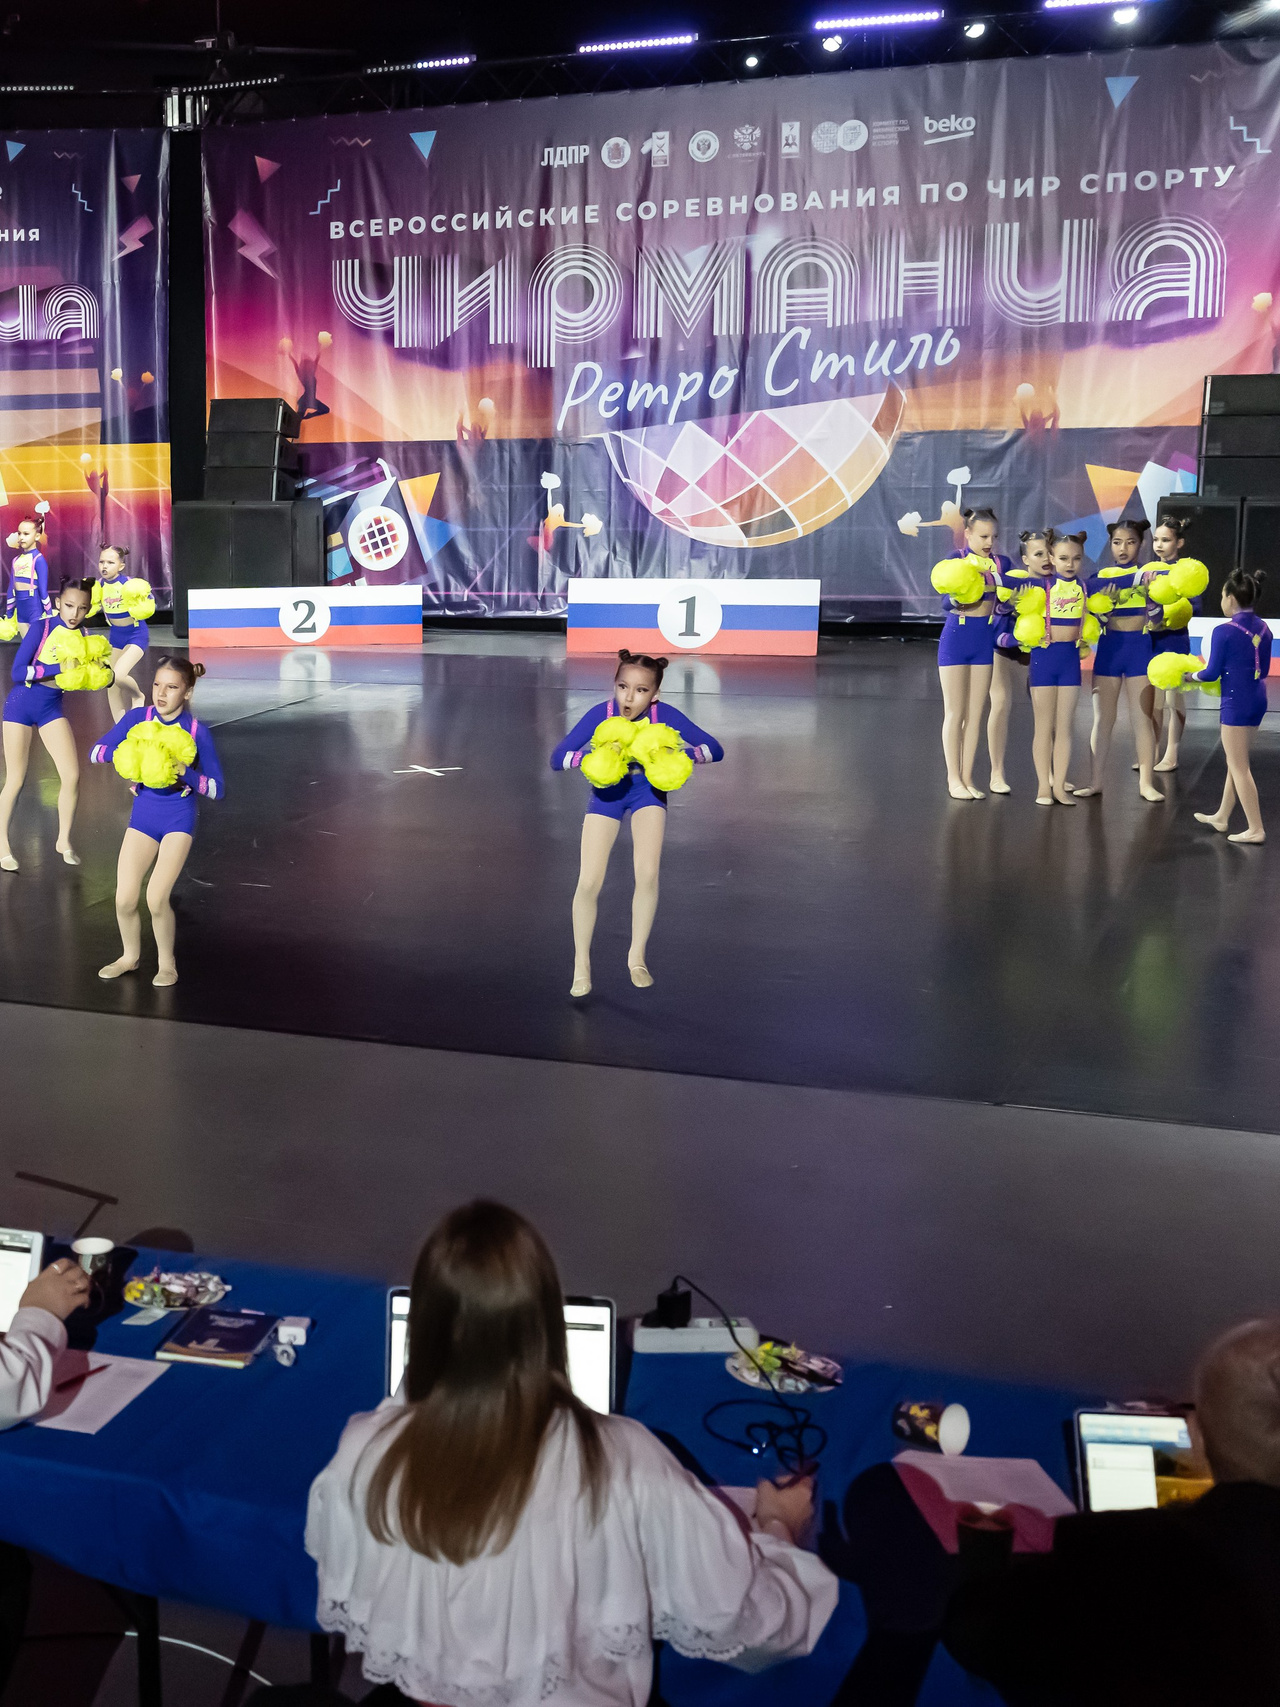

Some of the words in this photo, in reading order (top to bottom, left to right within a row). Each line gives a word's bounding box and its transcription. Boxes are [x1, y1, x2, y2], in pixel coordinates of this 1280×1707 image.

[923, 114, 976, 133] beko
[540, 145, 590, 168] ЛДПР
[330, 205, 600, 240] ВСЕРОССИЙСКИЕ
[616, 186, 901, 222] СОРЕВНОВАНИЯ
[920, 182, 968, 204] ПО
[987, 174, 1061, 200] ЧИР
[1080, 165, 1236, 194] СПОРТУ
[557, 360, 739, 431] Ретро
[764, 326, 961, 397] Стиль
[291, 598, 317, 634] 2
[677, 595, 701, 637] 1
